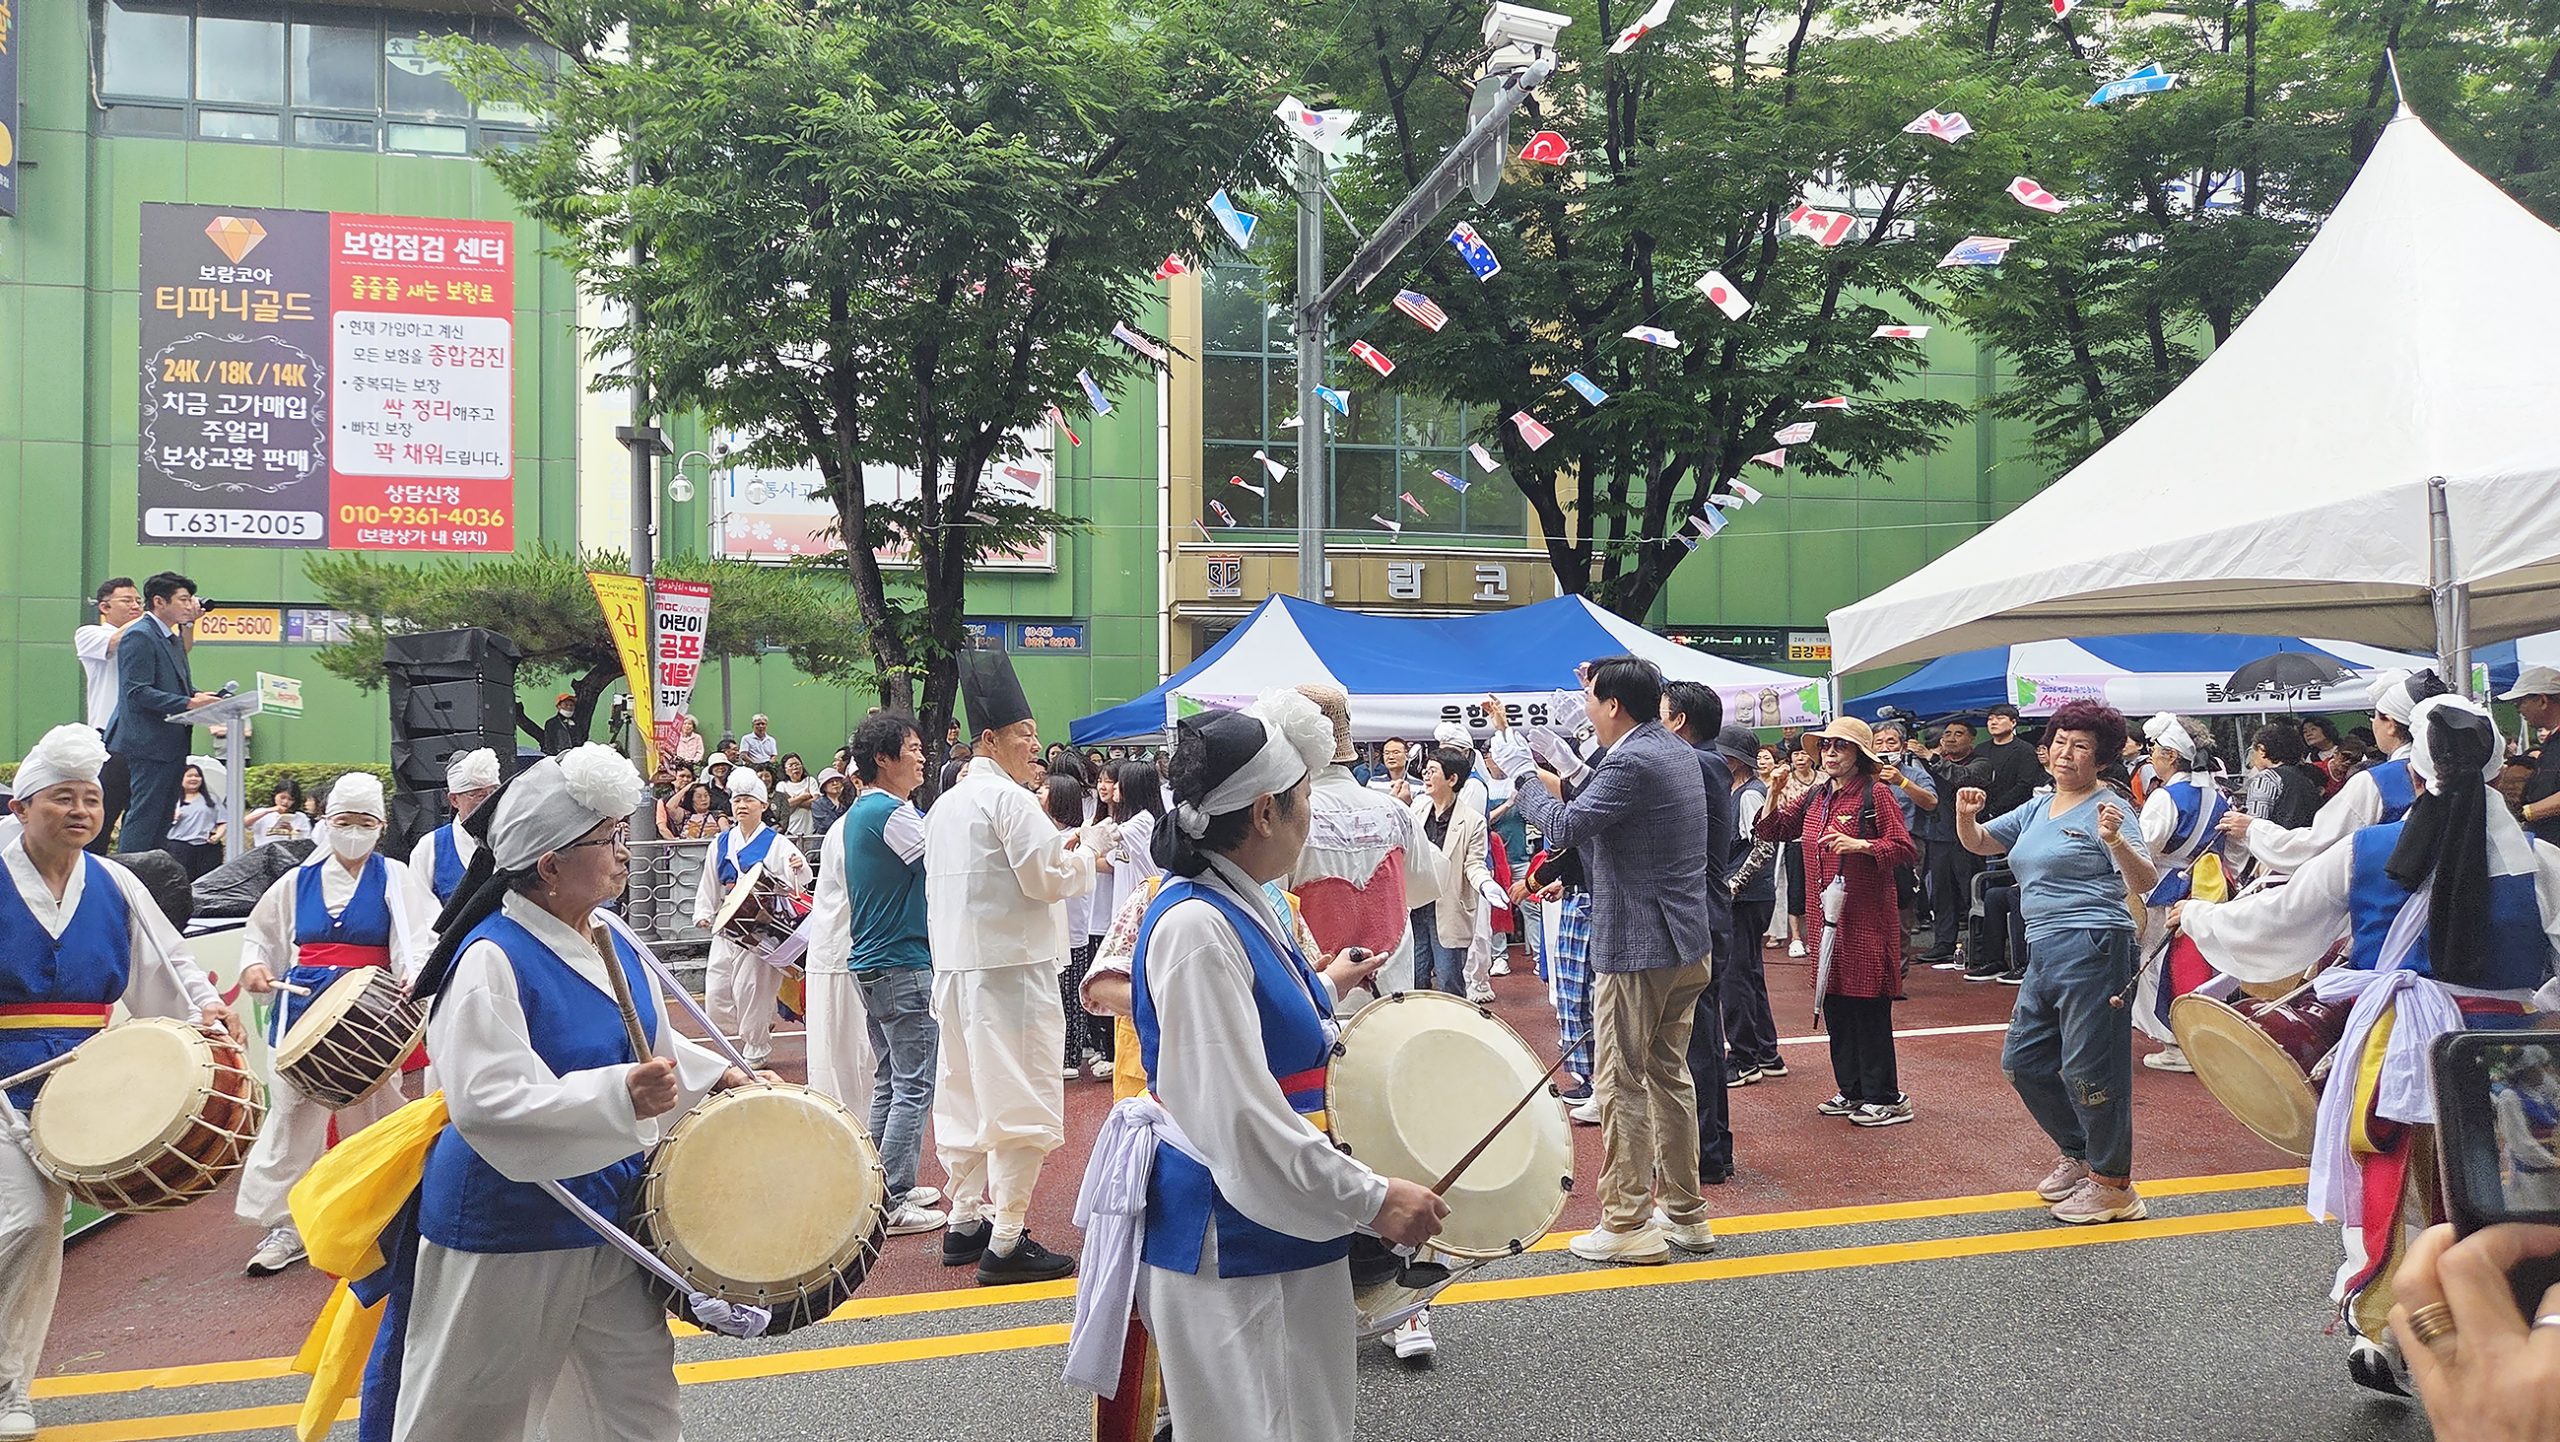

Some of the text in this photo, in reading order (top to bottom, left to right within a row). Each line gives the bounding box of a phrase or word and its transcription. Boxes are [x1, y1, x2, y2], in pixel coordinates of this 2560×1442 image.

[342, 232, 504, 266] 보험점검 센터
[198, 265, 273, 285] 보람코아
[350, 275, 494, 304] 줄줄줄 새는 보험료
[155, 285, 314, 323] 티파니골드
[349, 321, 464, 339] 현재 가입하고 계신
[352, 344, 504, 369] 모든 보험을 종합검진
[163, 358, 200, 384] 24K
[219, 361, 253, 386] 18K
[272, 362, 306, 387] 14K
[352, 376, 440, 393] 중복되는 보장
[162, 391, 307, 419] 치금 고가매입
[383, 398, 495, 422] 싹 정리해주고
[201, 421, 269, 445] 주얼리
[351, 421, 412, 438] 빠진 보장
[162, 446, 309, 473] 보상교환 판매
[373, 443, 504, 467] 꽉 채워드립니다.
[384, 485, 460, 503] 상담신청
[164, 513, 305, 535] T.631-2005
[340, 505, 504, 527] 010-9361-4036
[357, 528, 487, 547] (보람상가 내 위치)
[202, 616, 272, 635] 626-5600
[659, 613, 702, 632] 어린이
[659, 634, 700, 660] 공포
[659, 662, 698, 687] 체험
[1504, 703, 1562, 727] 운영
